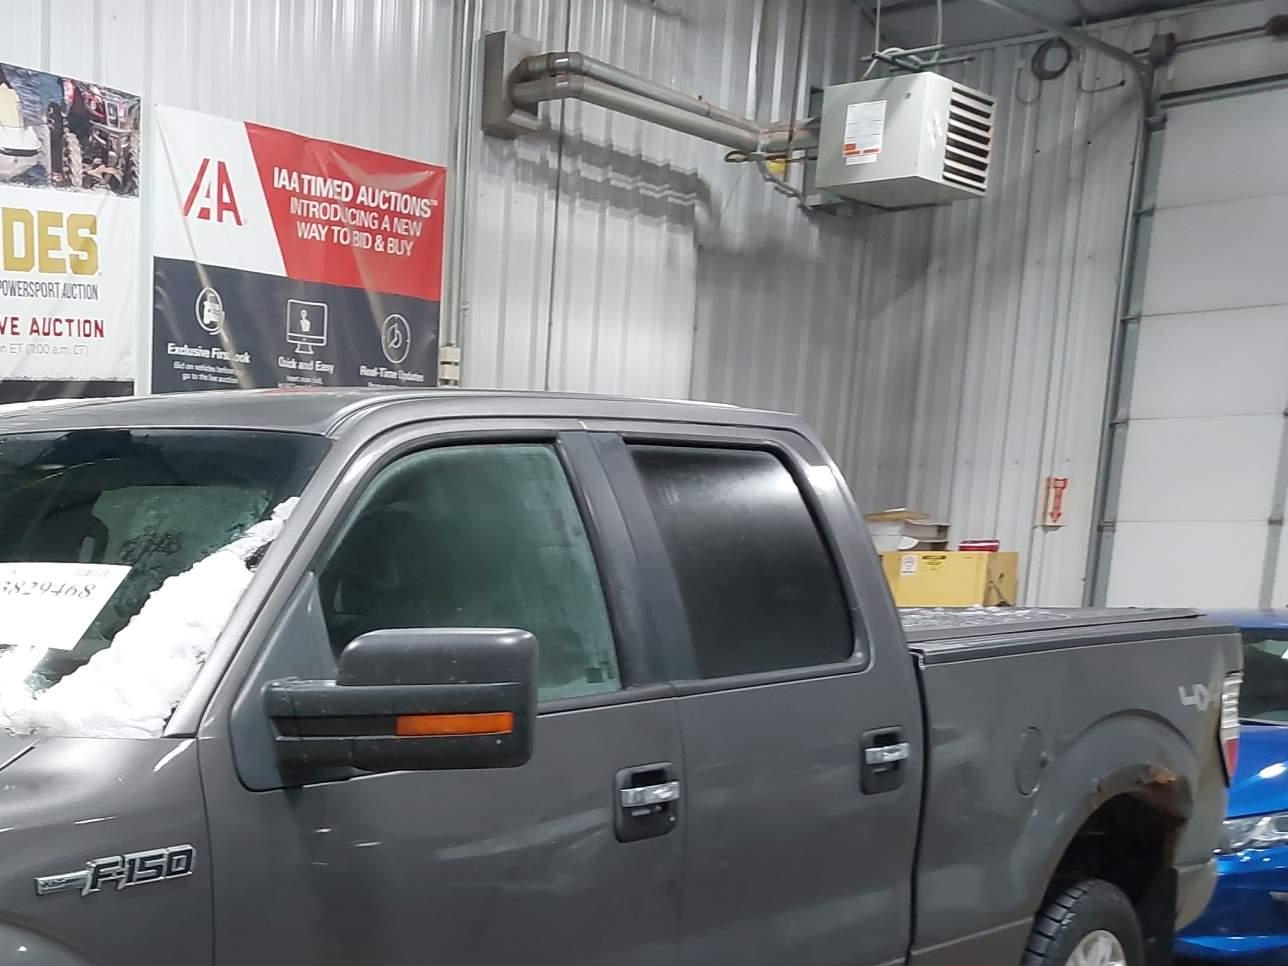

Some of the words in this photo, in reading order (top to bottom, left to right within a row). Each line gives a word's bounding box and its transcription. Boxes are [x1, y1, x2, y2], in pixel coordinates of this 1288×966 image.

[273, 167, 299, 192] IAA
[301, 174, 353, 202] TIMED
[290, 197, 379, 230] INTRODUCING
[381, 215, 390, 231] A
[393, 217, 423, 237] NEW
[296, 221, 329, 242] WAY
[332, 226, 351, 245] TO
[352, 231, 372, 249] BID
[374, 235, 384, 252] &
[387, 238, 414, 256] BUY
[61, 283, 99, 300] AUCTION
[29, 317, 105, 338] AUCTION
[10, 344, 24, 354] ET
[167, 342, 210, 358] Exclusive
[232, 352, 251, 363] ook
[278, 356, 298, 369] Quick
[298, 360, 313, 371] and
[315, 361, 334, 374] Easy
[359, 365, 397, 379] Real-Time
